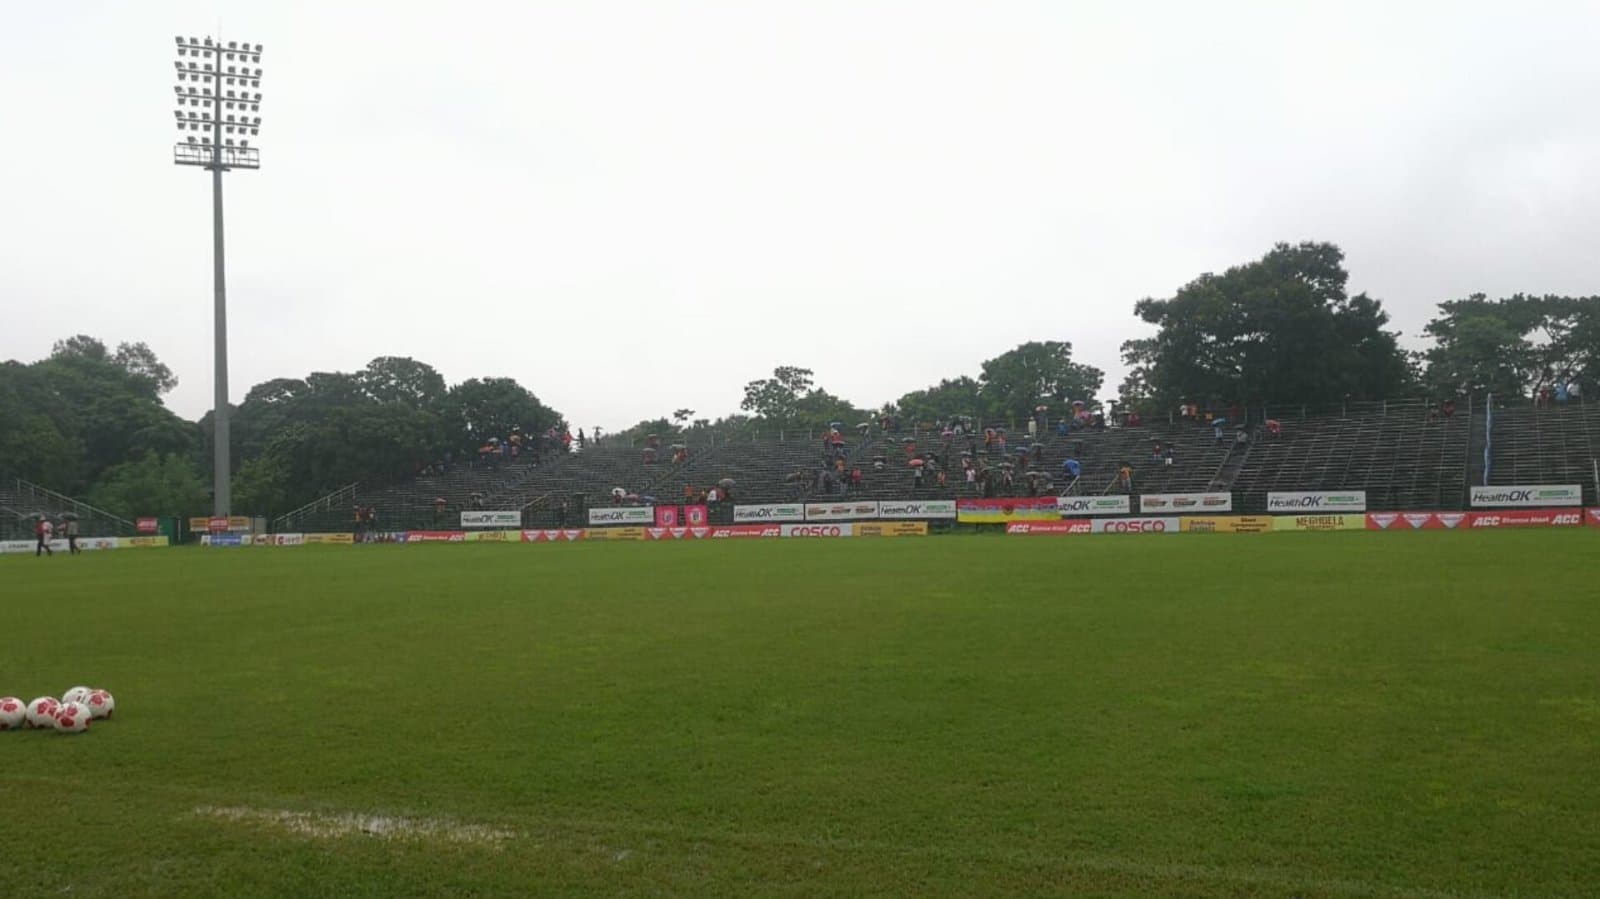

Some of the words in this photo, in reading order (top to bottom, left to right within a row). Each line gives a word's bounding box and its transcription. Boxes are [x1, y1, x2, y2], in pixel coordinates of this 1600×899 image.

[1473, 490, 1532, 502] HealthOK
[1473, 516, 1500, 526] ACC
[1552, 514, 1580, 524] ACC
[791, 526, 841, 537] COSCO
[1008, 524, 1030, 533] ACC
[1067, 524, 1091, 533] ACC
[1104, 521, 1165, 533] COSCO
